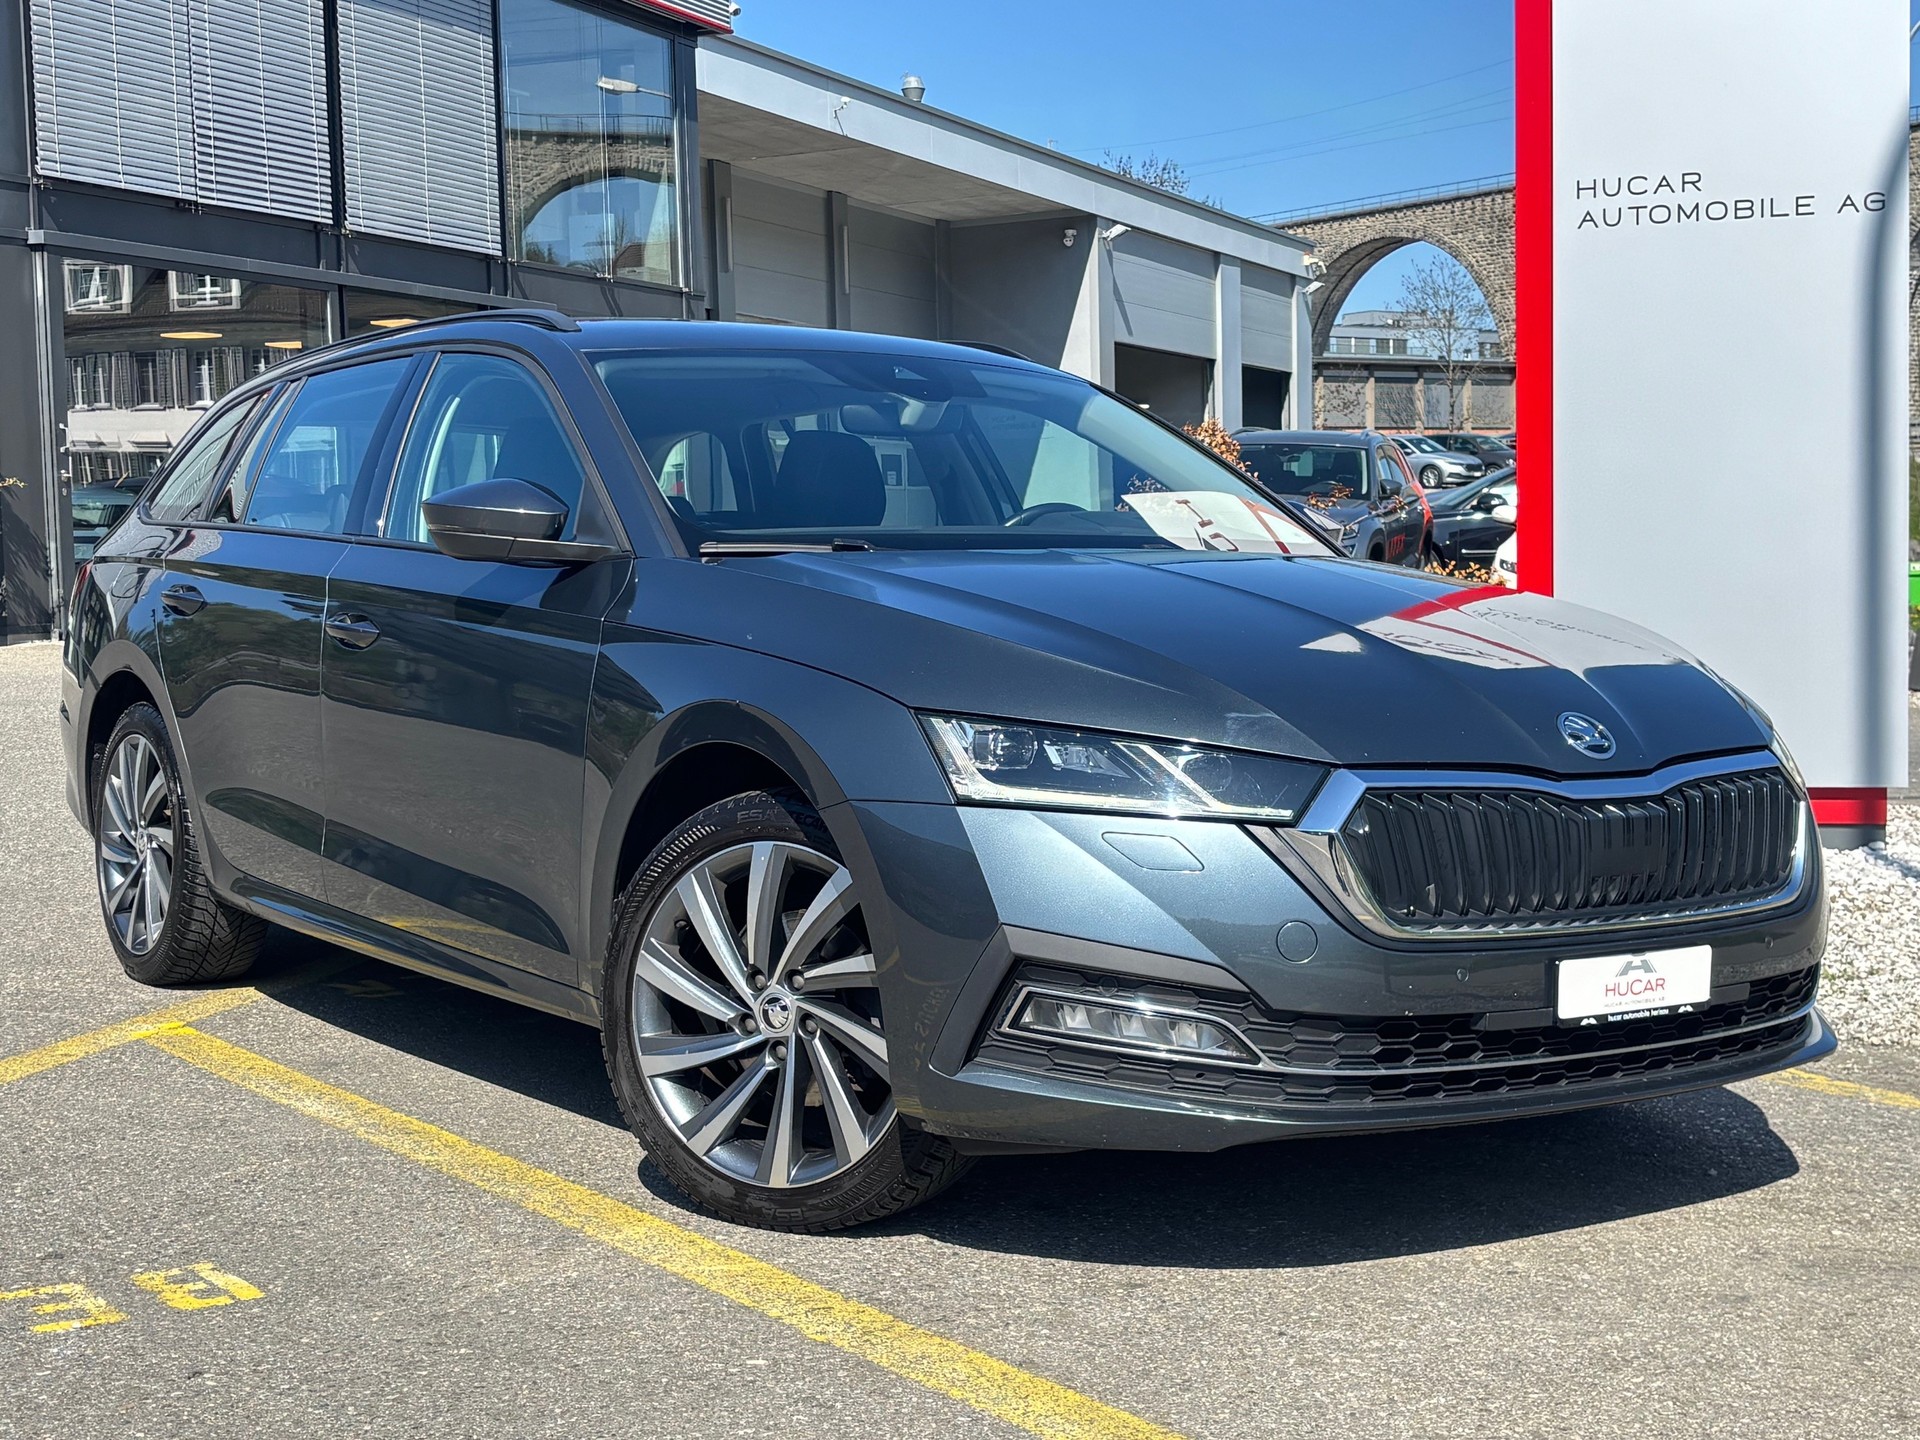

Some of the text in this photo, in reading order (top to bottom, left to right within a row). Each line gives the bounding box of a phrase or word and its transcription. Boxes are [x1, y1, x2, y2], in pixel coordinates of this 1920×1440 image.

[1575, 171, 1703, 200] HUCAR
[1576, 191, 1887, 230] AUTOMOBILE AG
[1605, 977, 1666, 997] HUCAR
